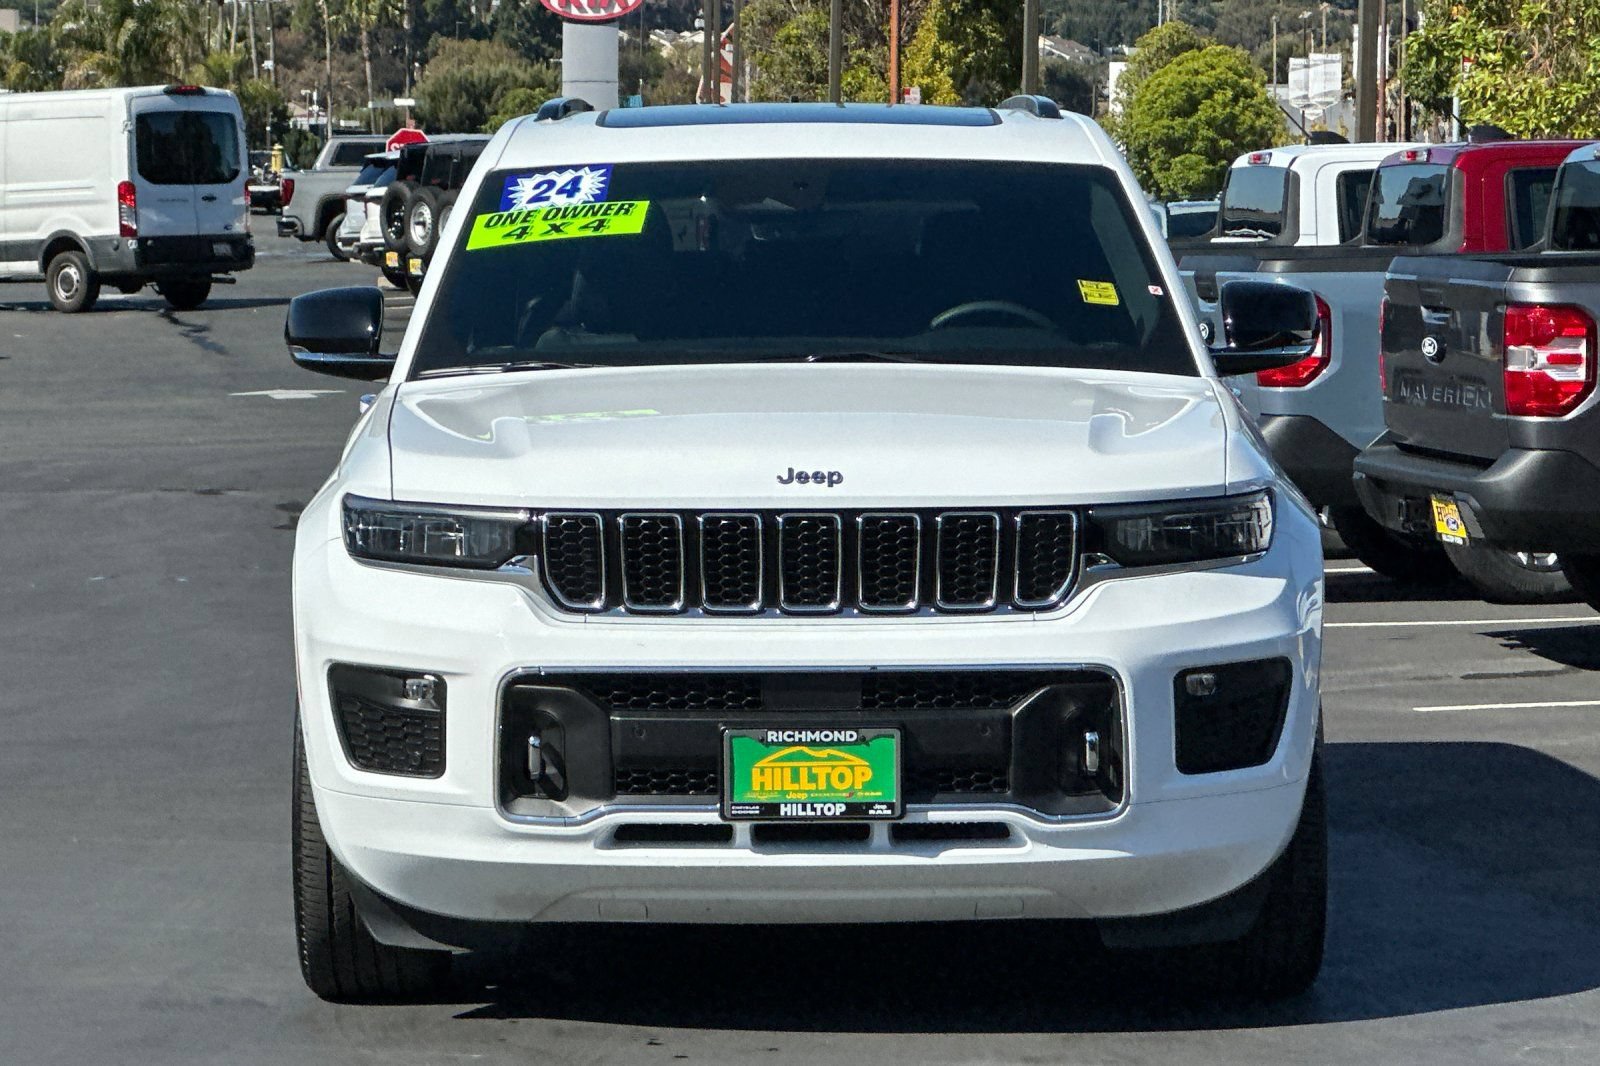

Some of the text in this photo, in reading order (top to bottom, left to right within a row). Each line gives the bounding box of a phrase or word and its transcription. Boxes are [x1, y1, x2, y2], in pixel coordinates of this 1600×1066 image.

[526, 175, 582, 204] 24
[484, 203, 635, 228] ONE OWNER
[501, 224, 534, 240] 4
[577, 217, 611, 232] 4
[776, 467, 844, 488] Jeep
[767, 730, 858, 743] RICHMOND
[752, 767, 872, 790] HILLTOP
[786, 791, 808, 799] Jeep
[780, 803, 847, 816] HILLTOP
